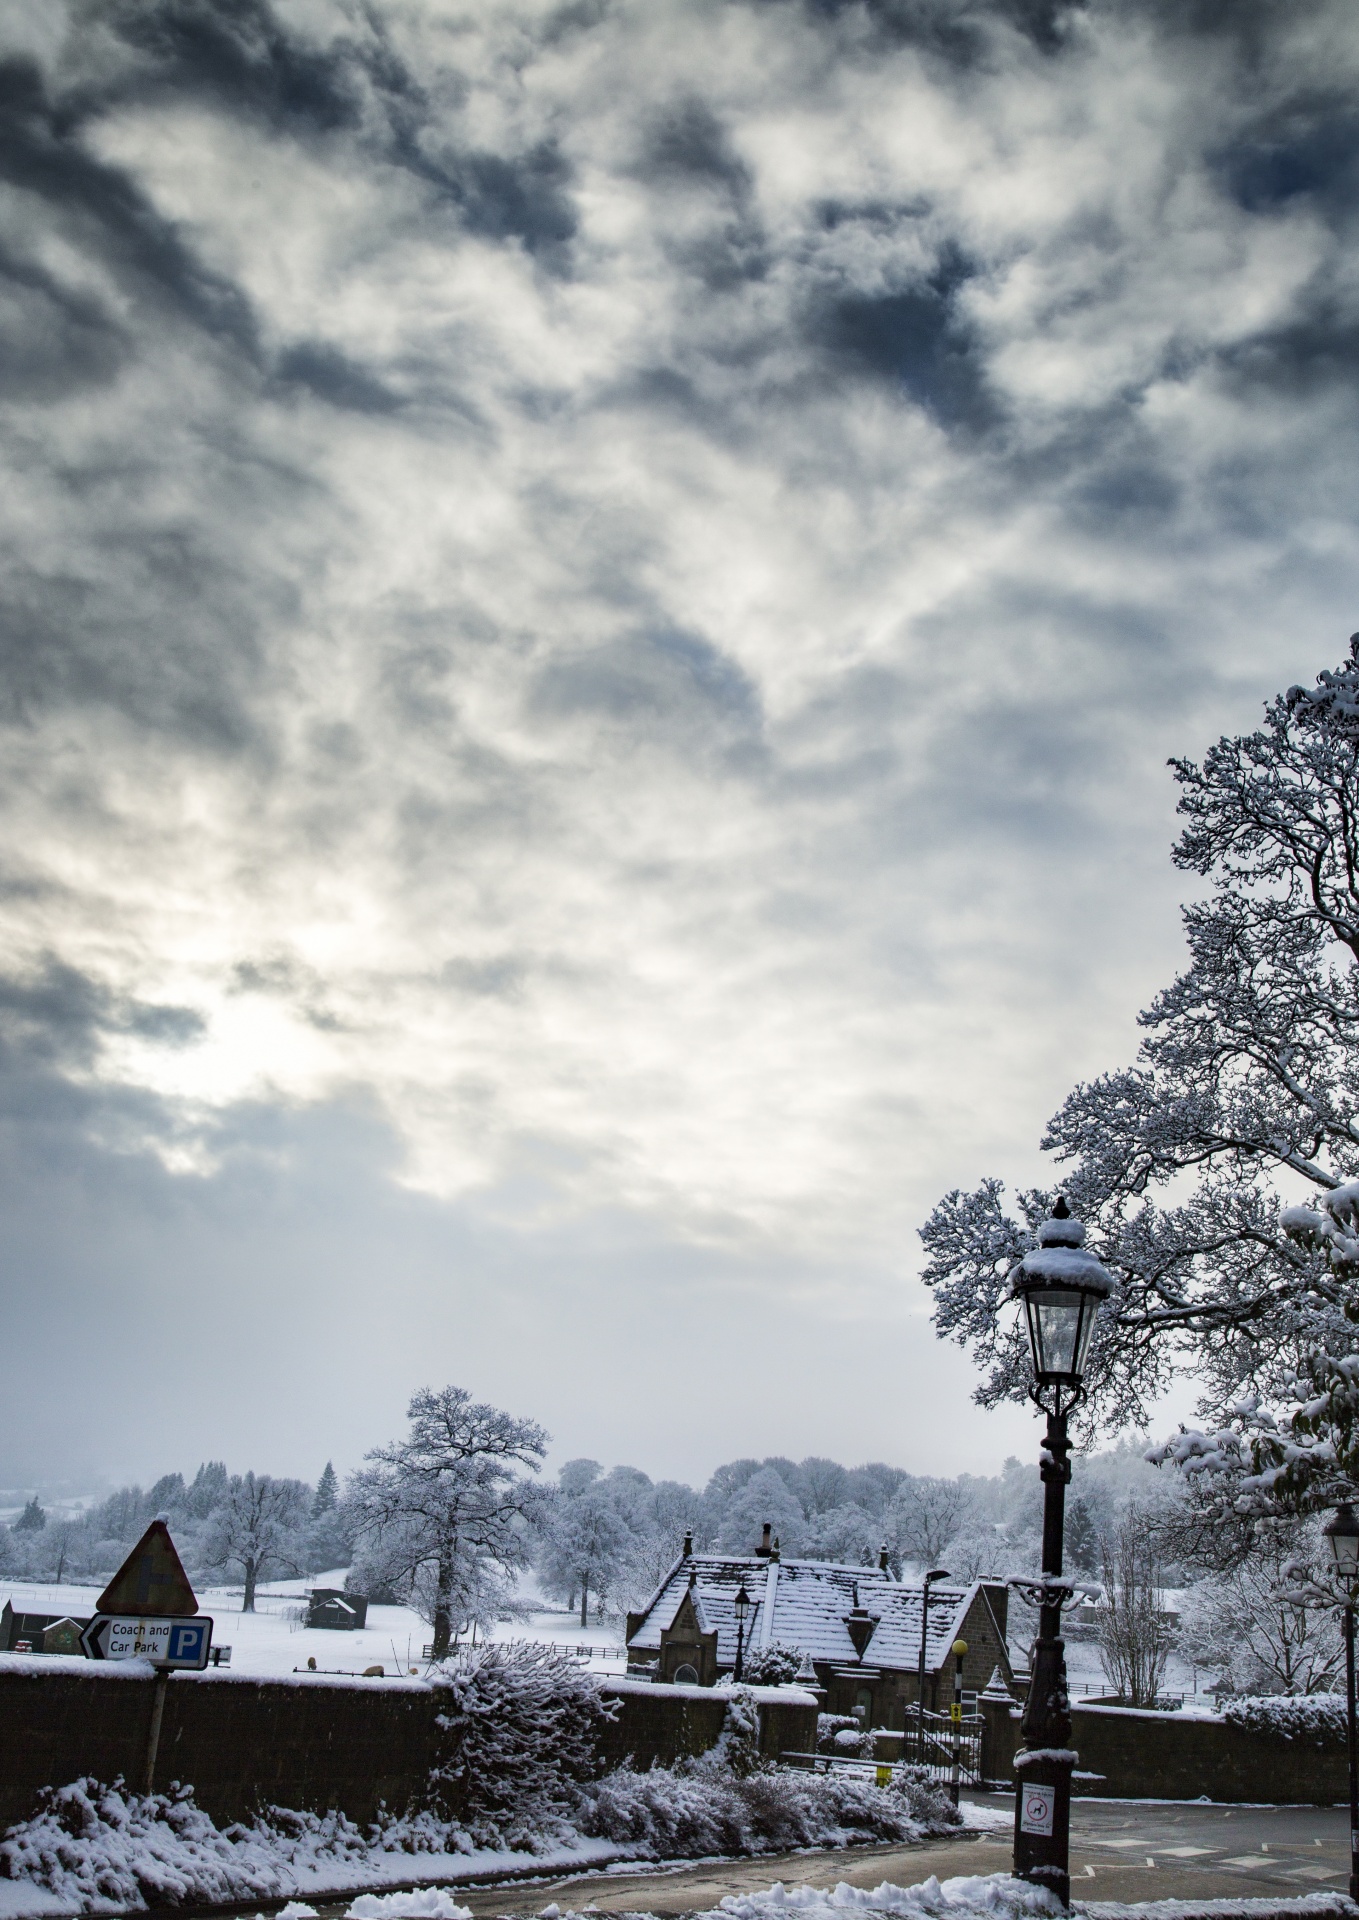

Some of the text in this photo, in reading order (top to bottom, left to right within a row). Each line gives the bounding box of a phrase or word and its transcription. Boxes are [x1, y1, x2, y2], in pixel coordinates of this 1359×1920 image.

[112, 1624, 170, 1636] Coach and
[110, 1641, 159, 1653] Car Park
[176, 1629, 198, 1657] P
